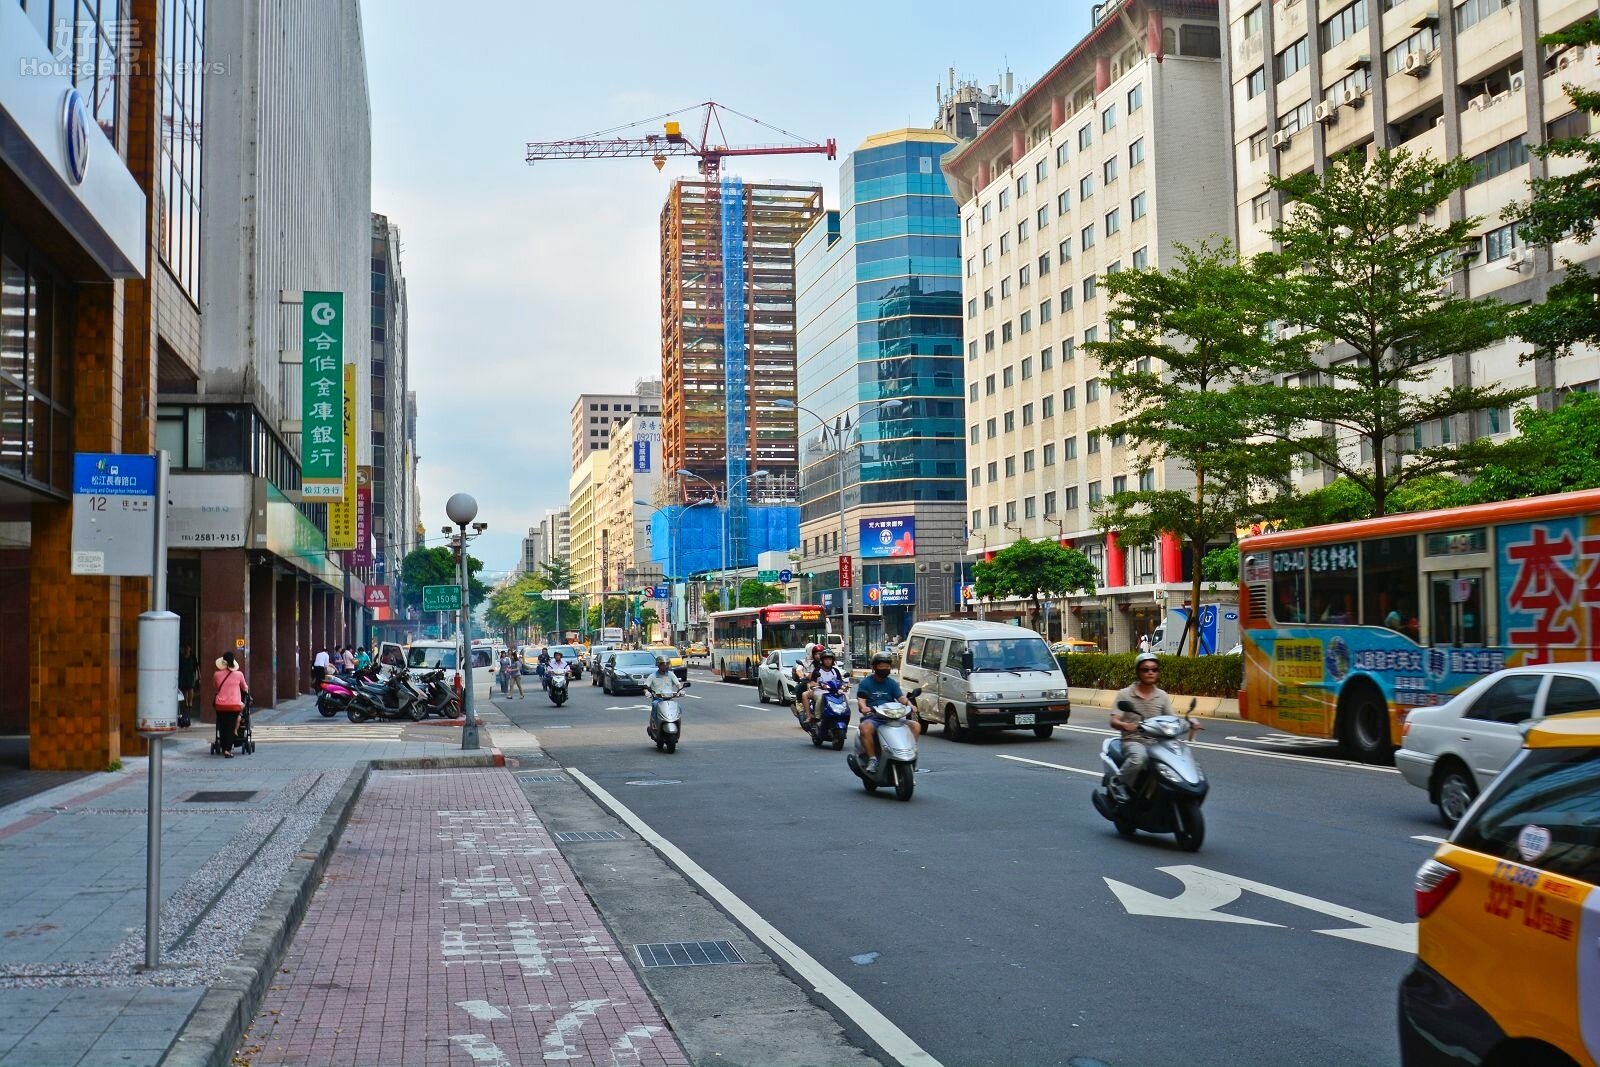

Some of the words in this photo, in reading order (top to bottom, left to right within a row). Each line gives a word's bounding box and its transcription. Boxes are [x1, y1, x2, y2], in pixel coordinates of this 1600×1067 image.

[308, 332, 338, 468] 合作金庫銀行
[91, 476, 137, 486] 松江長春路口
[303, 484, 341, 495] 松江分行
[88, 496, 107, 512] 12
[195, 533, 240, 542] 2581-9151
